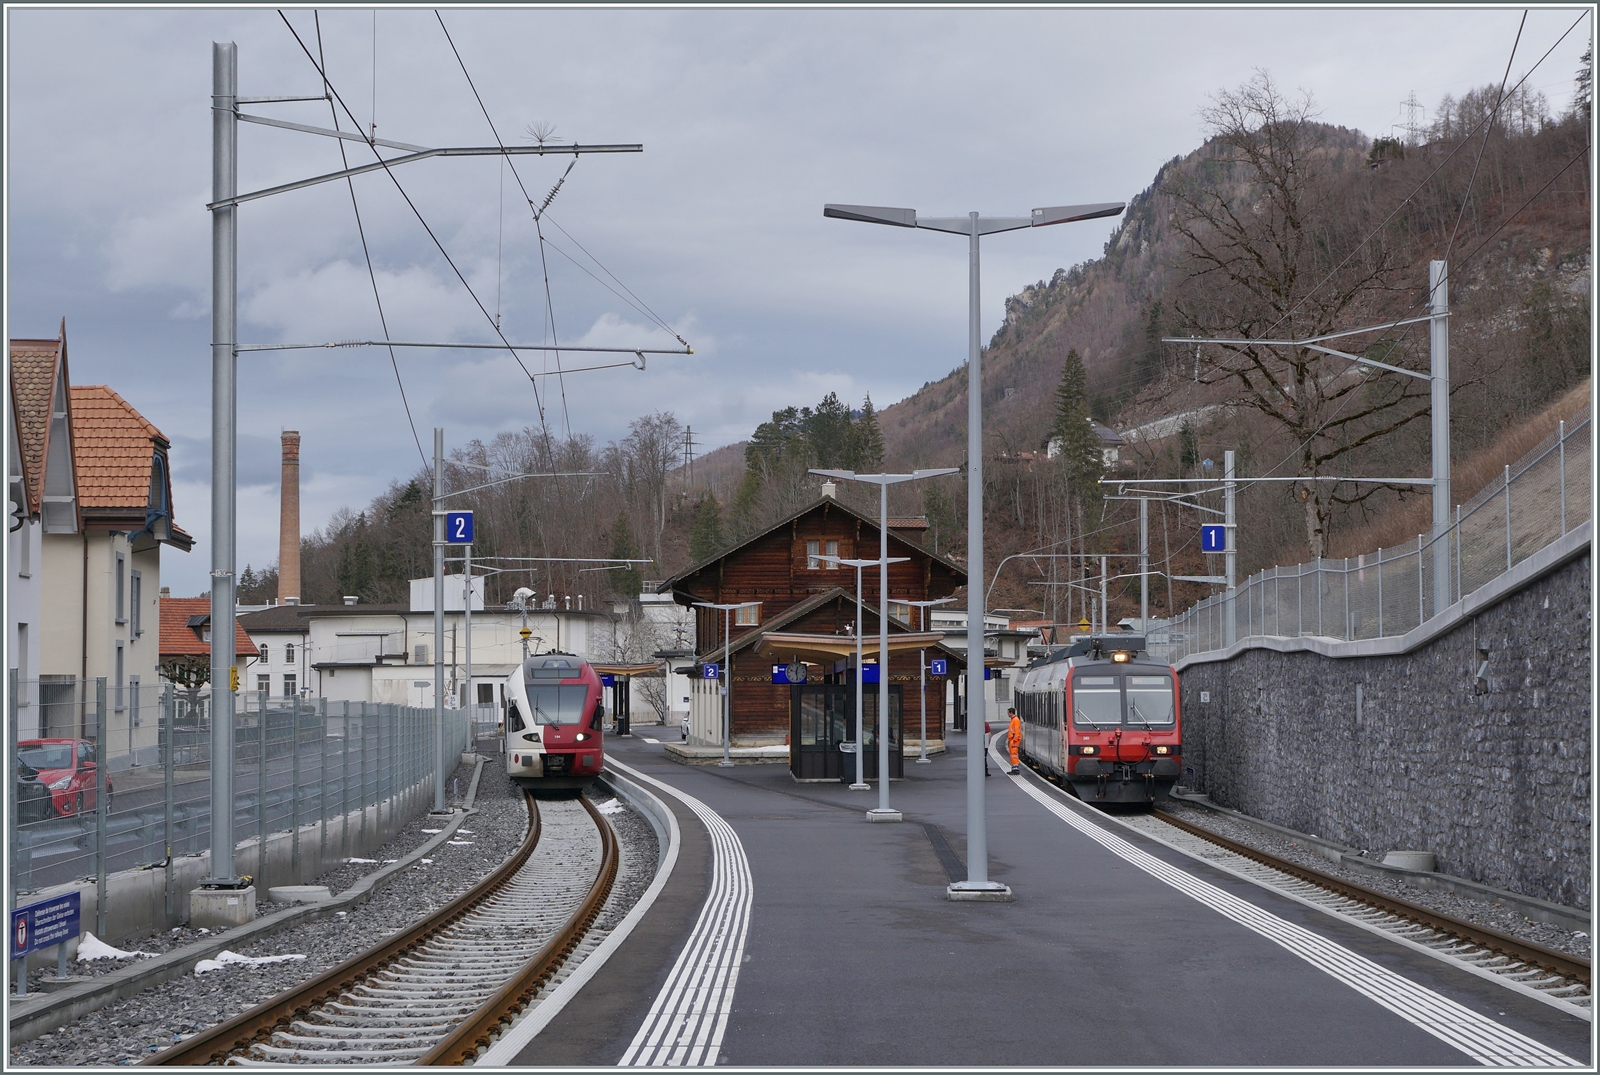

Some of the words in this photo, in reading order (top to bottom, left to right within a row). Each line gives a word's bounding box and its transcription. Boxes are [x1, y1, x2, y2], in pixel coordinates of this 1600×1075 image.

[456, 518, 465, 538] 2
[1210, 530, 1215, 547] 1
[708, 668, 714, 676] 2
[937, 664, 941, 673] 1
